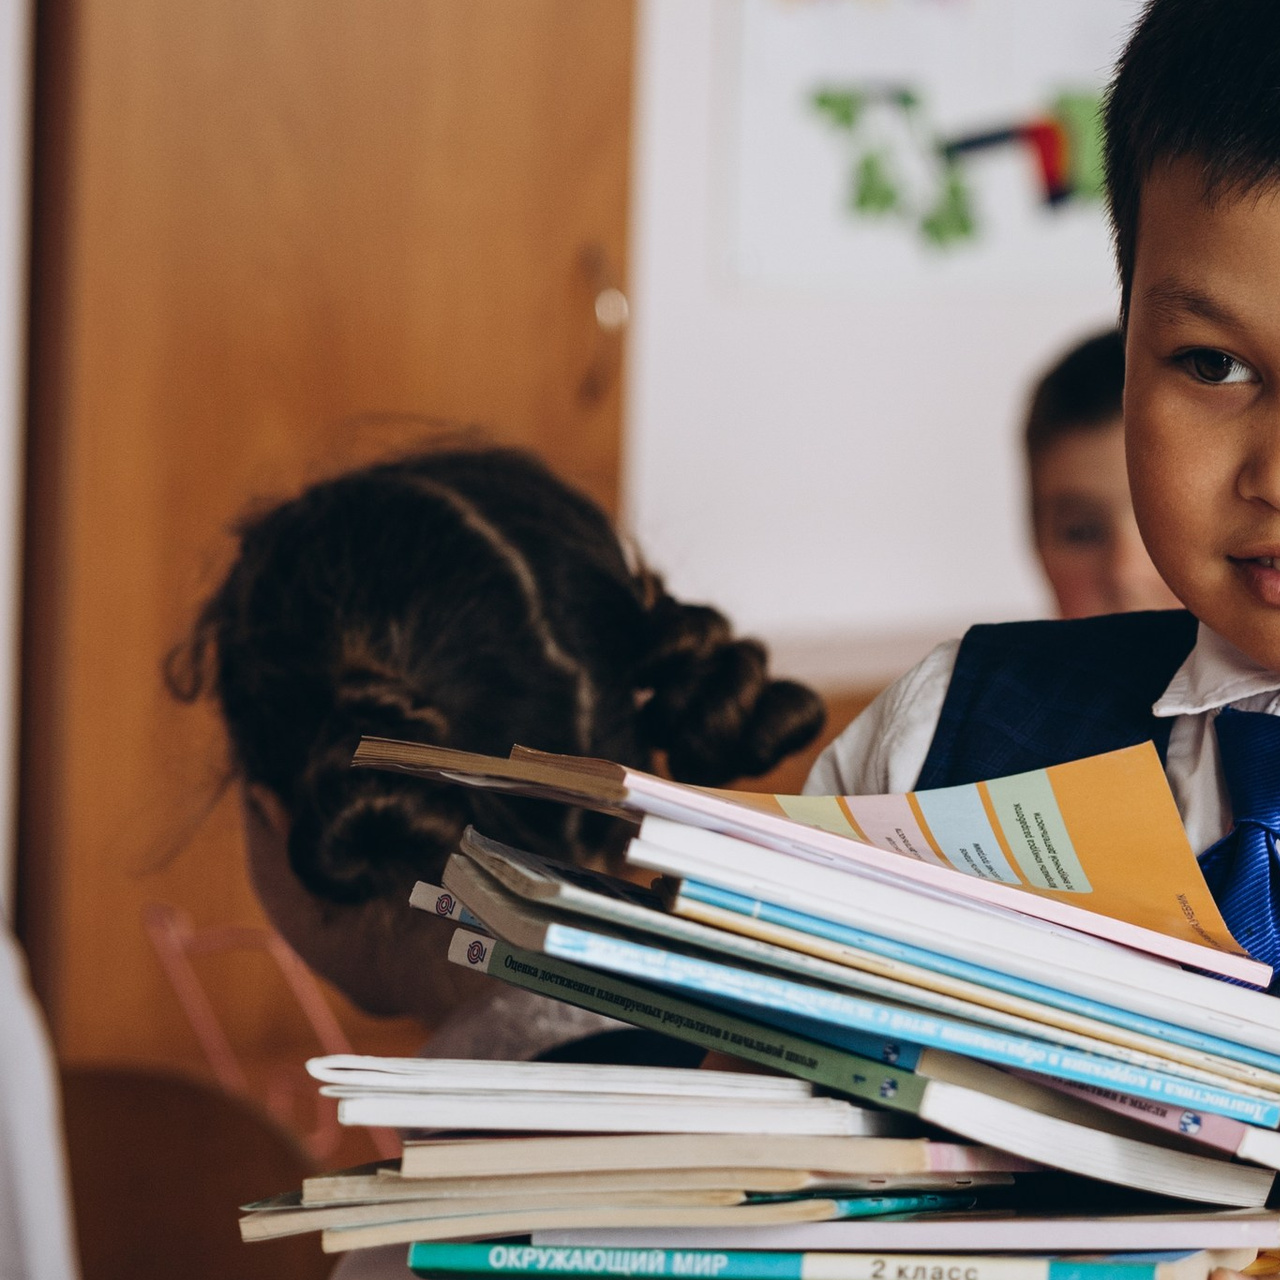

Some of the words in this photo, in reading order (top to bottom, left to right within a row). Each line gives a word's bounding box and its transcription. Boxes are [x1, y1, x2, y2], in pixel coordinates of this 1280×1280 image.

[1033, 811, 1057, 854] деятельности
[504, 954, 539, 978] Оценка
[539, 969, 596, 997] достижения
[596, 988, 663, 1021] планируемых
[663, 1003, 722, 1039] результатов
[487, 1245, 666, 1277] ОКРУЖАЮЩИЙ
[672, 1251, 729, 1277] МИР
[871, 1258, 886, 1280] 2
